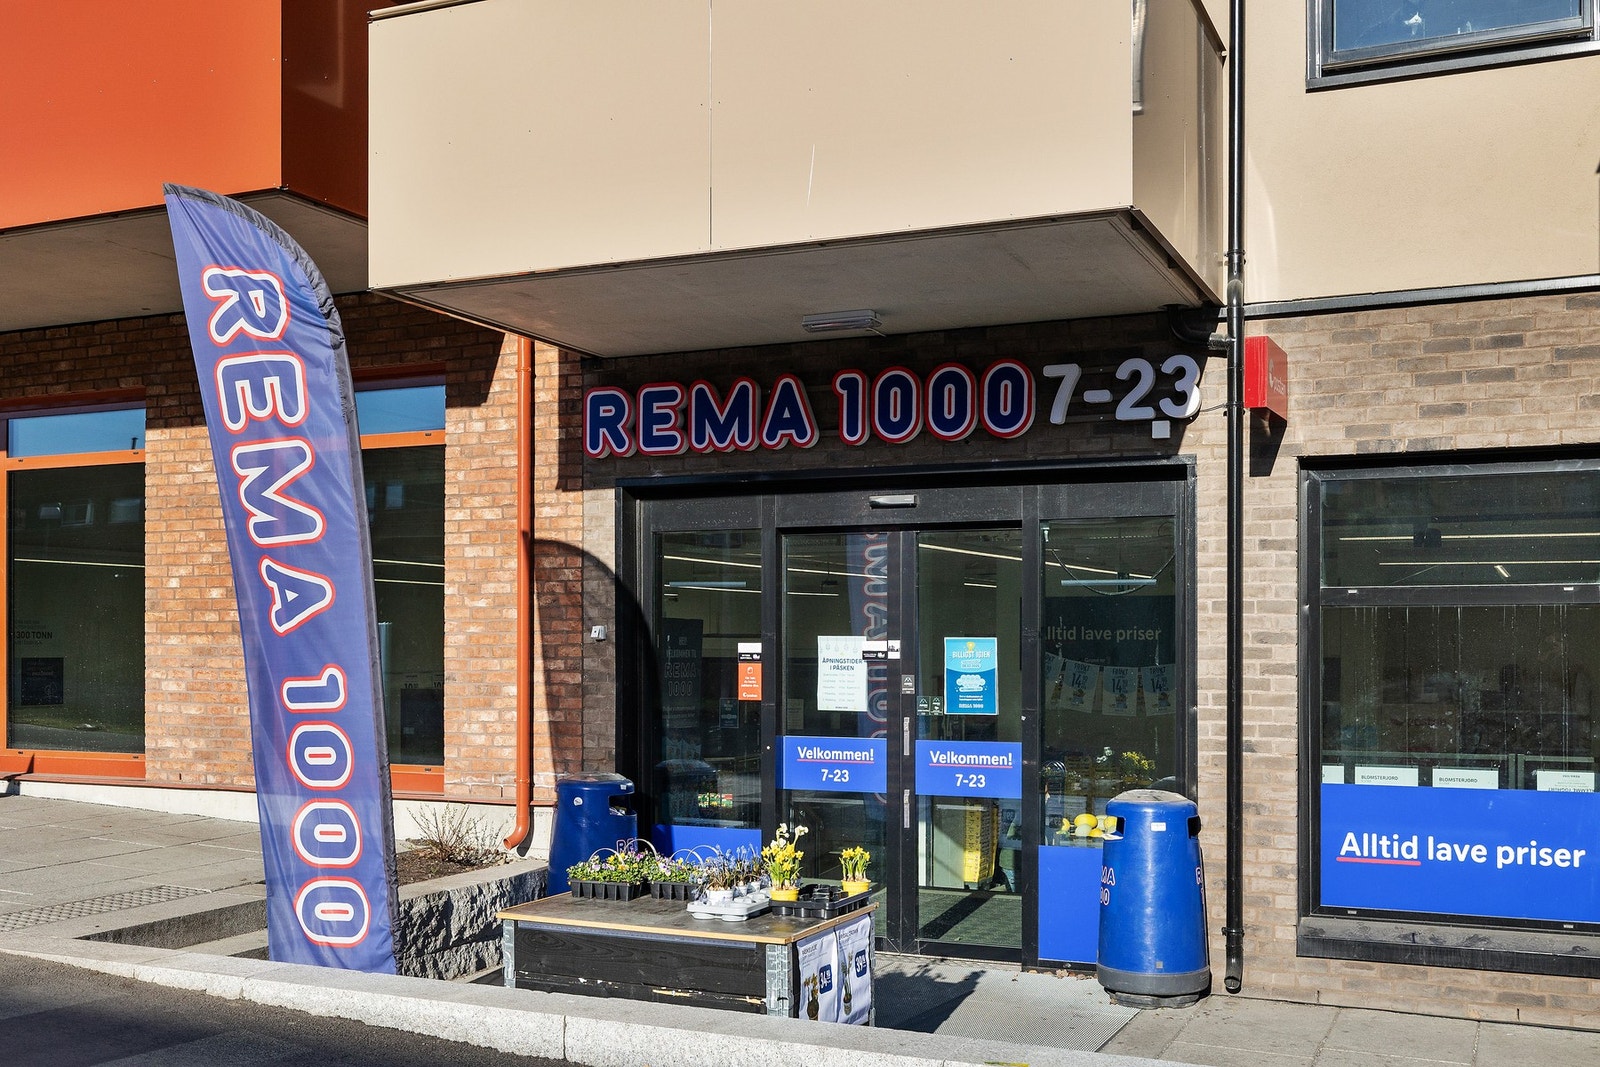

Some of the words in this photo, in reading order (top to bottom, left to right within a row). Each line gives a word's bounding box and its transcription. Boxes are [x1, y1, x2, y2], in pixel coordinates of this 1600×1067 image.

[583, 373, 819, 459] REMA
[832, 359, 1035, 446] 1000
[1043, 354, 1200, 425] 7-23
[201, 264, 336, 637] REMA
[280, 663, 371, 948] 1000
[32, 631, 53, 639] TONN
[1046, 626, 1076, 640] lltid
[1081, 626, 1112, 640] lave
[1116, 626, 1161, 643] priser
[663, 662, 696, 678] REMA
[668, 680, 693, 696] 1000
[797, 746, 874, 761] Velkommen!
[930, 750, 1013, 766] Velkommen!
[821, 769, 849, 782] 7-23
[955, 773, 986, 788] 7-23
[1438, 776, 1478, 784] BLOMSTERJORD
[1339, 832, 1418, 860] Alltid
[1427, 835, 1488, 863] lave
[1496, 840, 1586, 869] priser
